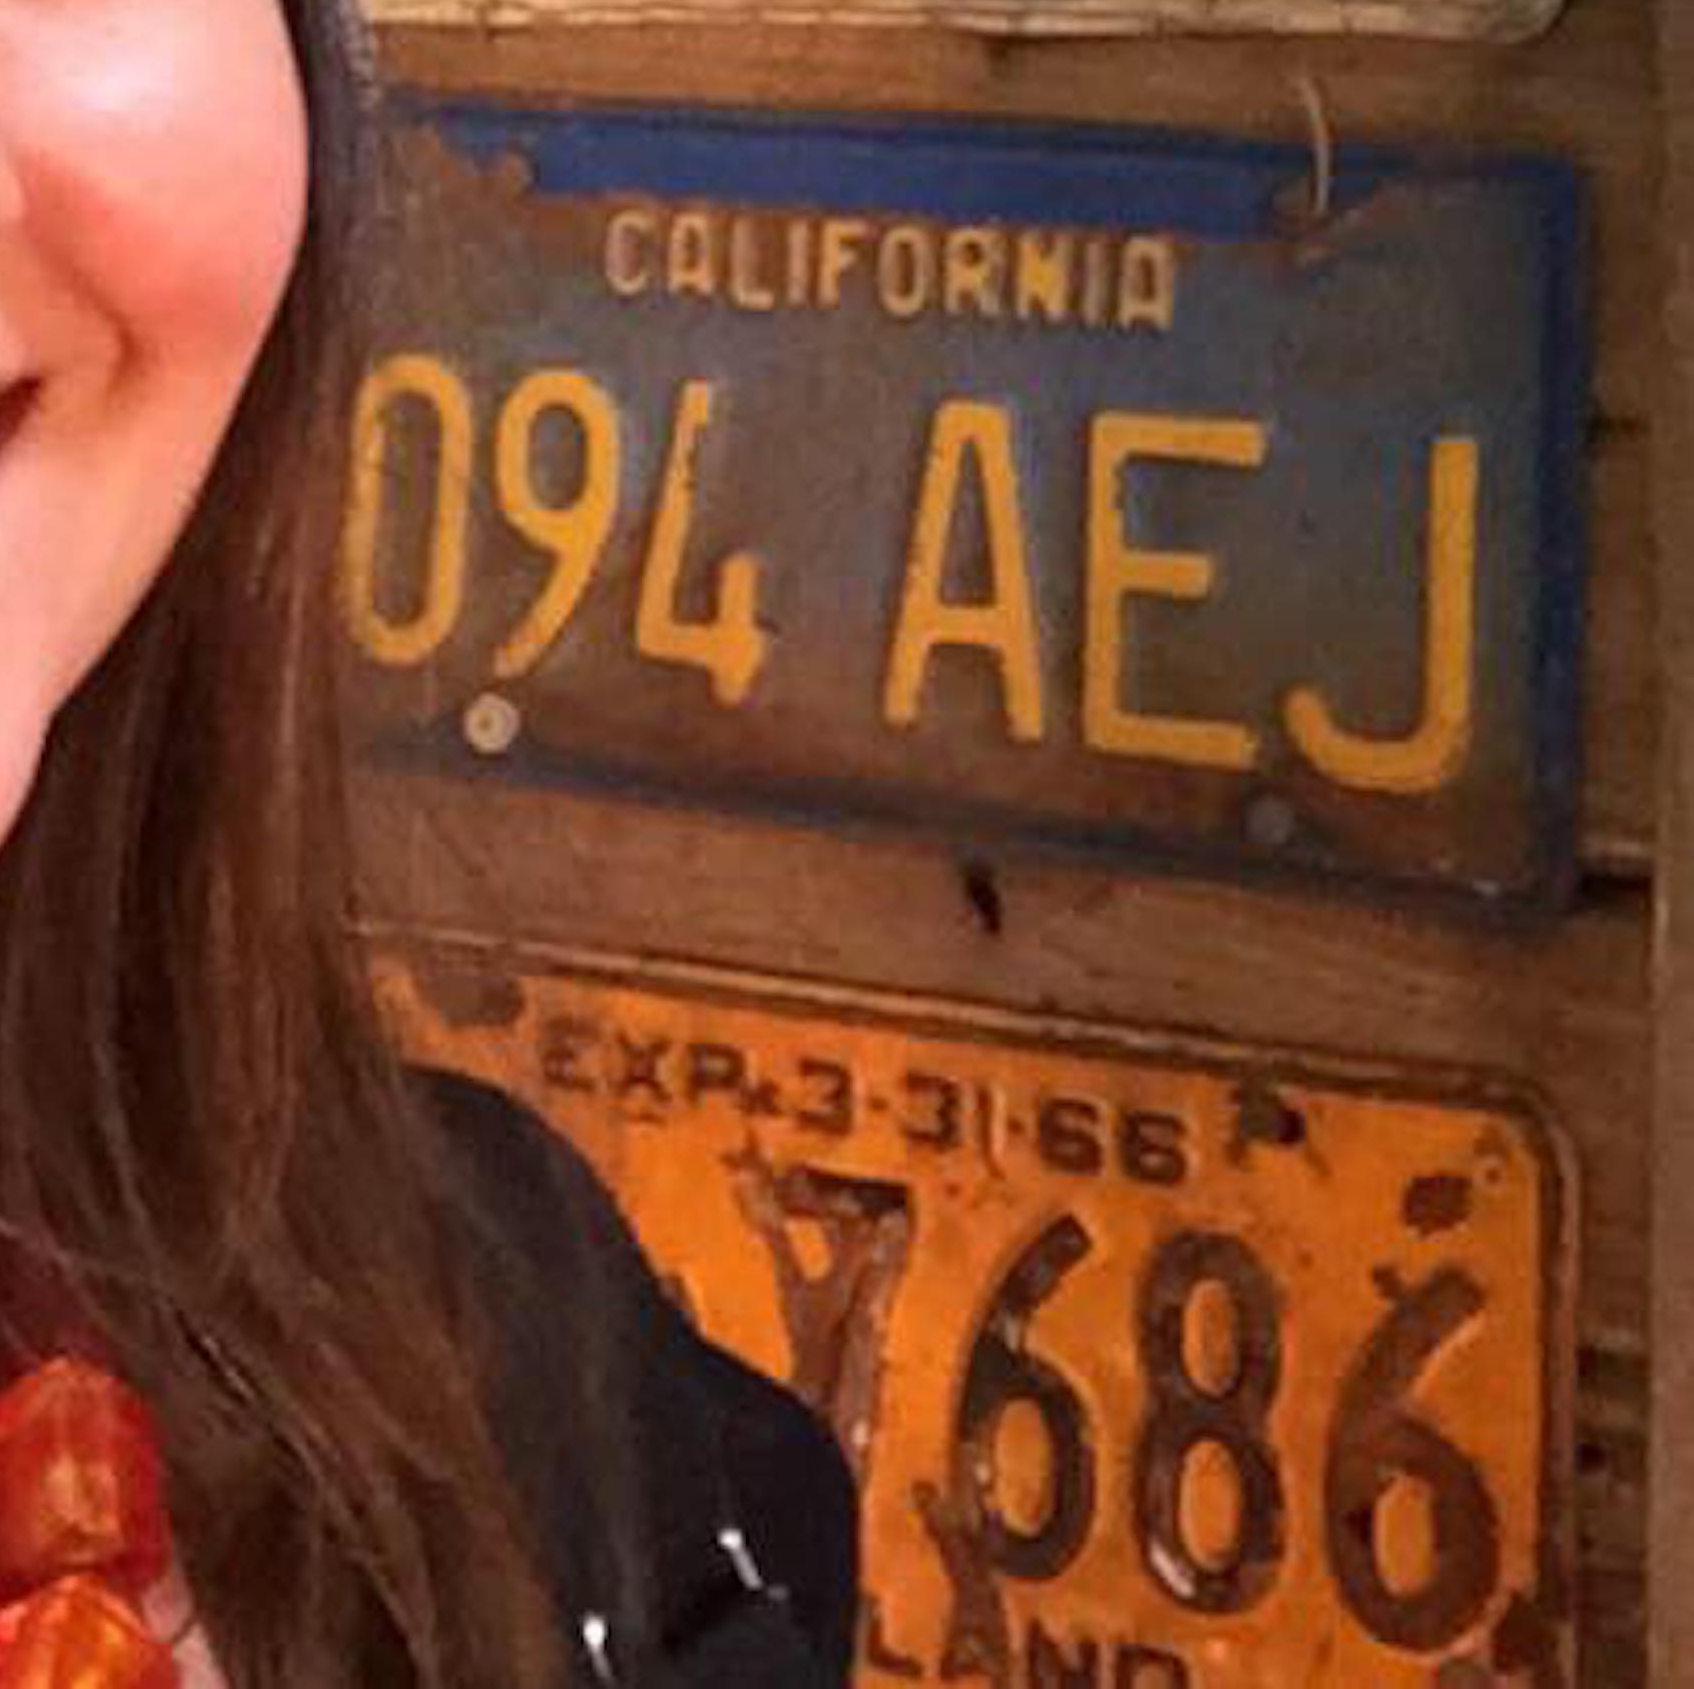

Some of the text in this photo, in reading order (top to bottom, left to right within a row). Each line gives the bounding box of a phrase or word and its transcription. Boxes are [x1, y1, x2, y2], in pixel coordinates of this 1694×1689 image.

[604, 208, 1176, 332] CALIFORNIA
[346, 352, 1480, 794] 094 AEJ
